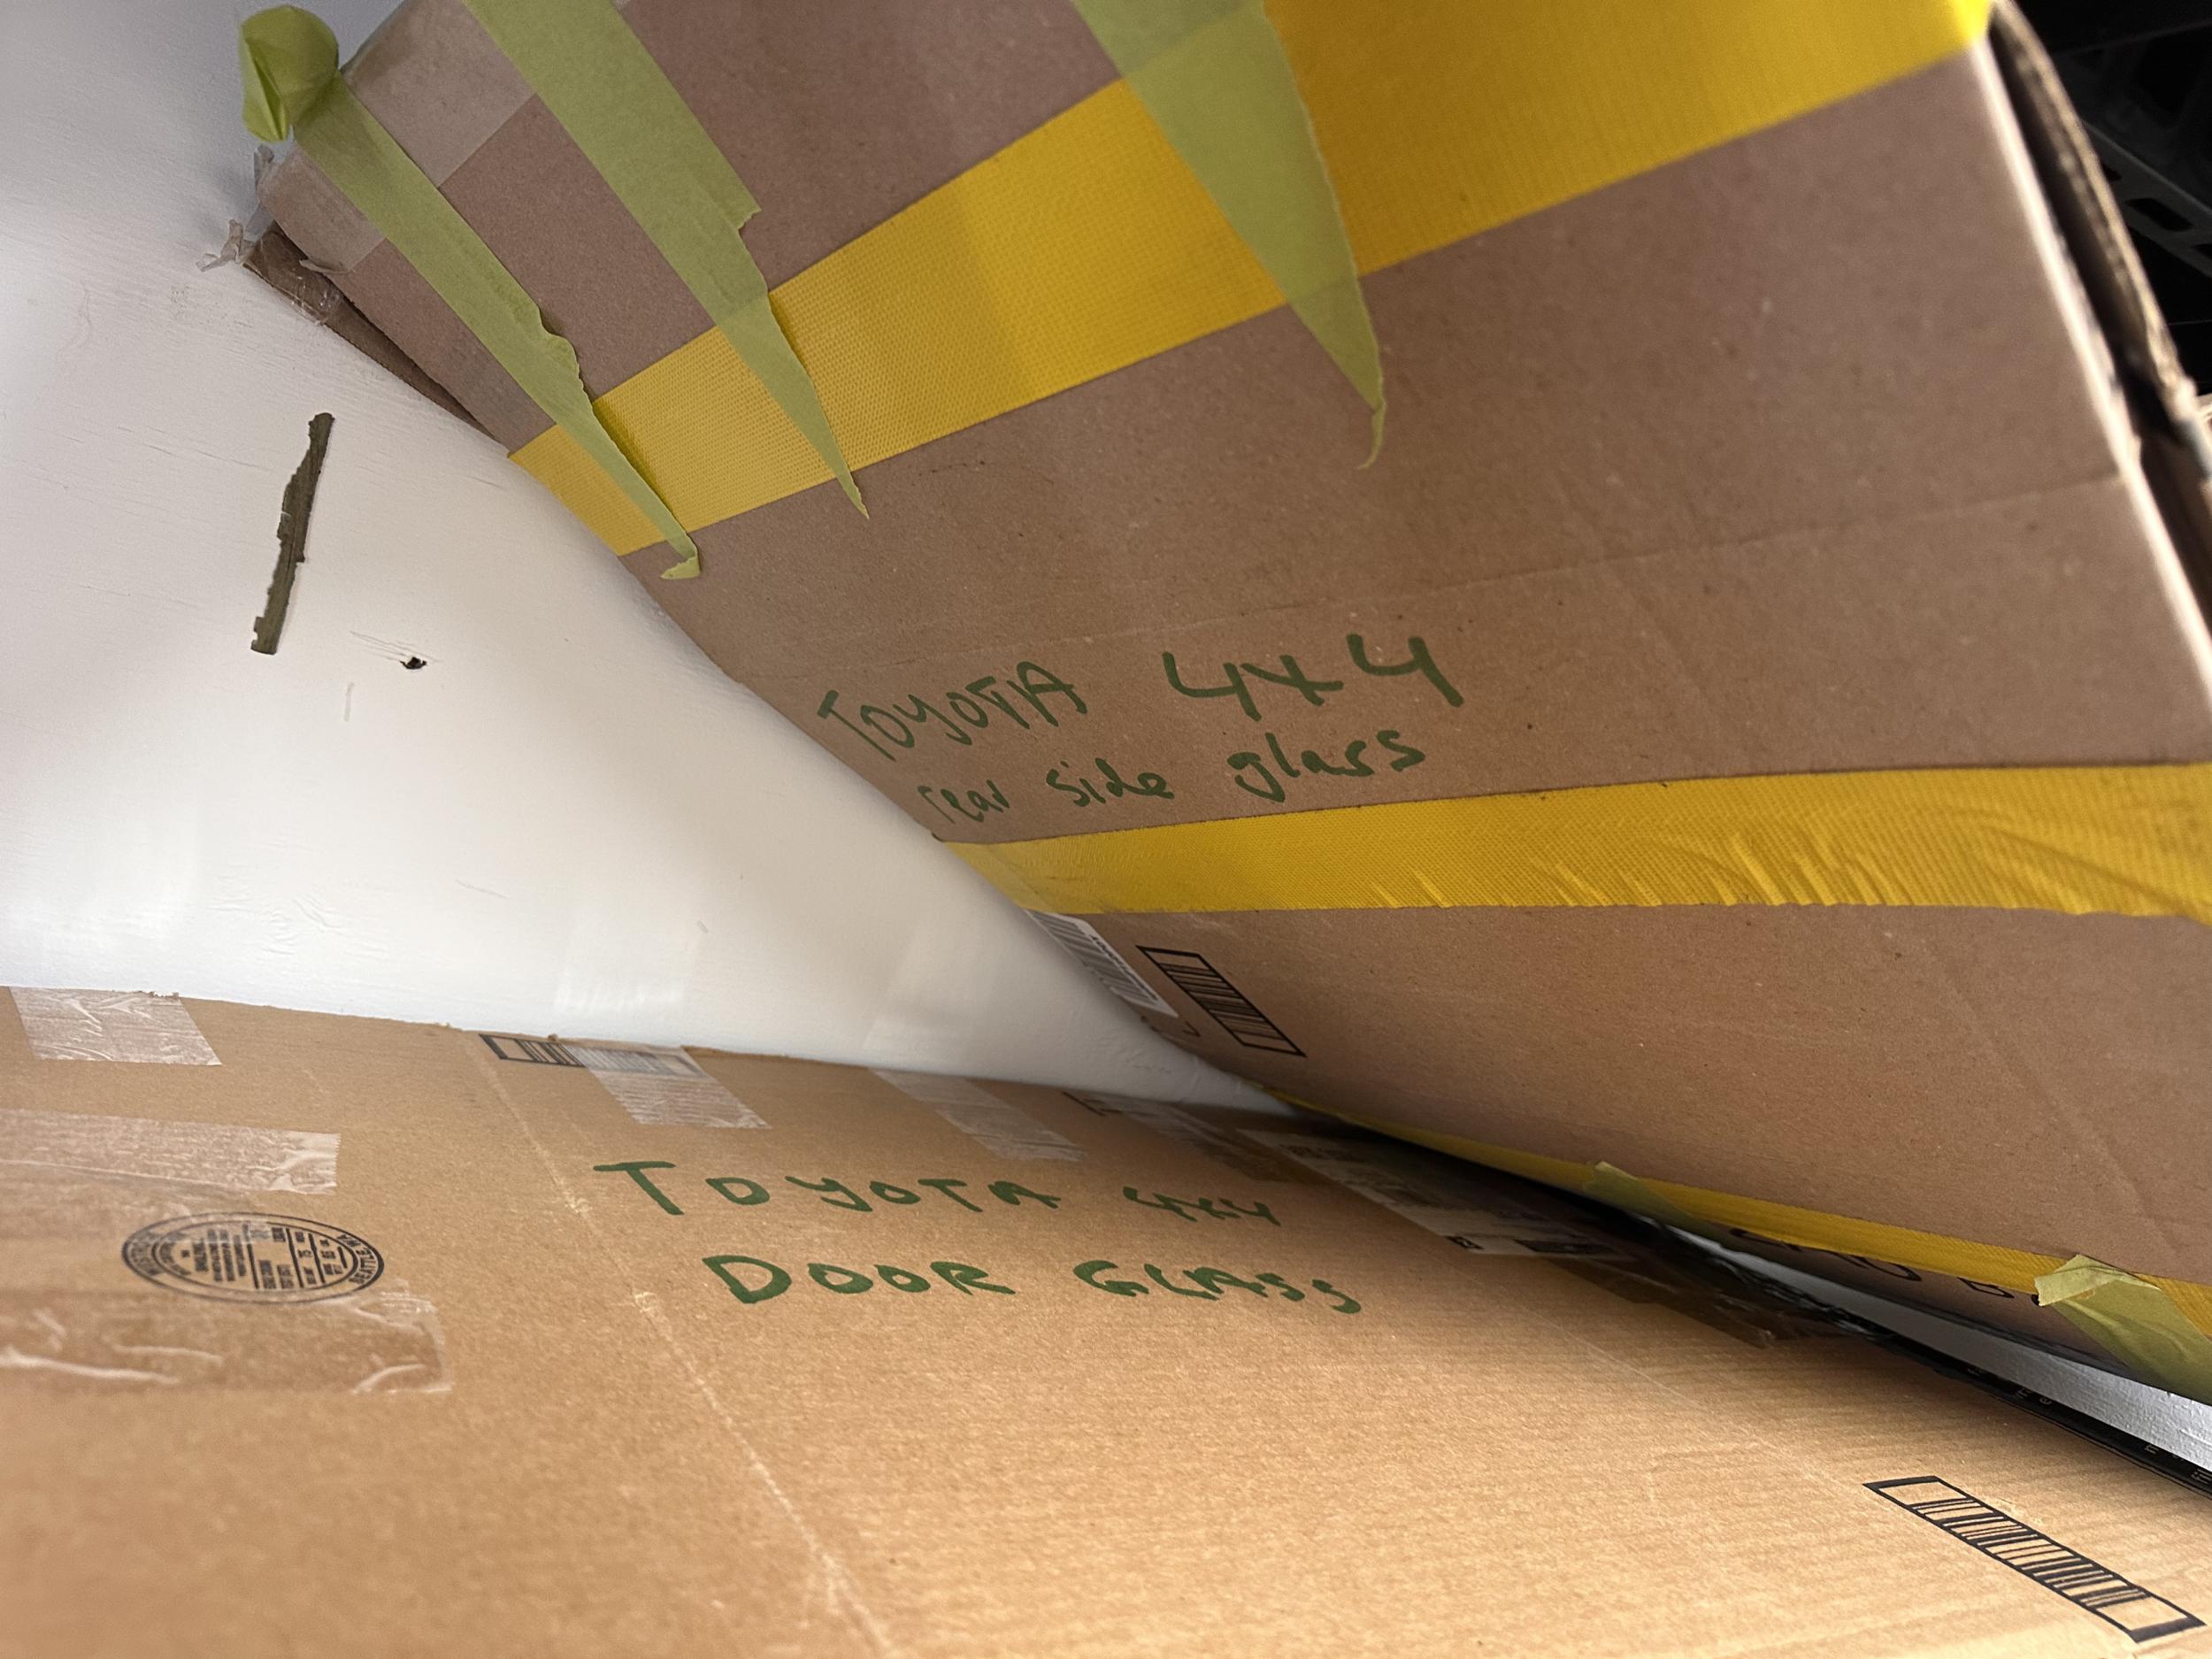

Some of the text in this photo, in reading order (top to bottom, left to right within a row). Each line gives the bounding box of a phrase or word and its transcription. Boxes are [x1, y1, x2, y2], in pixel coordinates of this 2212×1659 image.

[818, 661, 1087, 761] TOYOTA
[917, 730, 1425, 825] rear side glass
[593, 1160, 1061, 1216] TOYOTA
[702, 1255, 1362, 1314] DOOR GLASS
